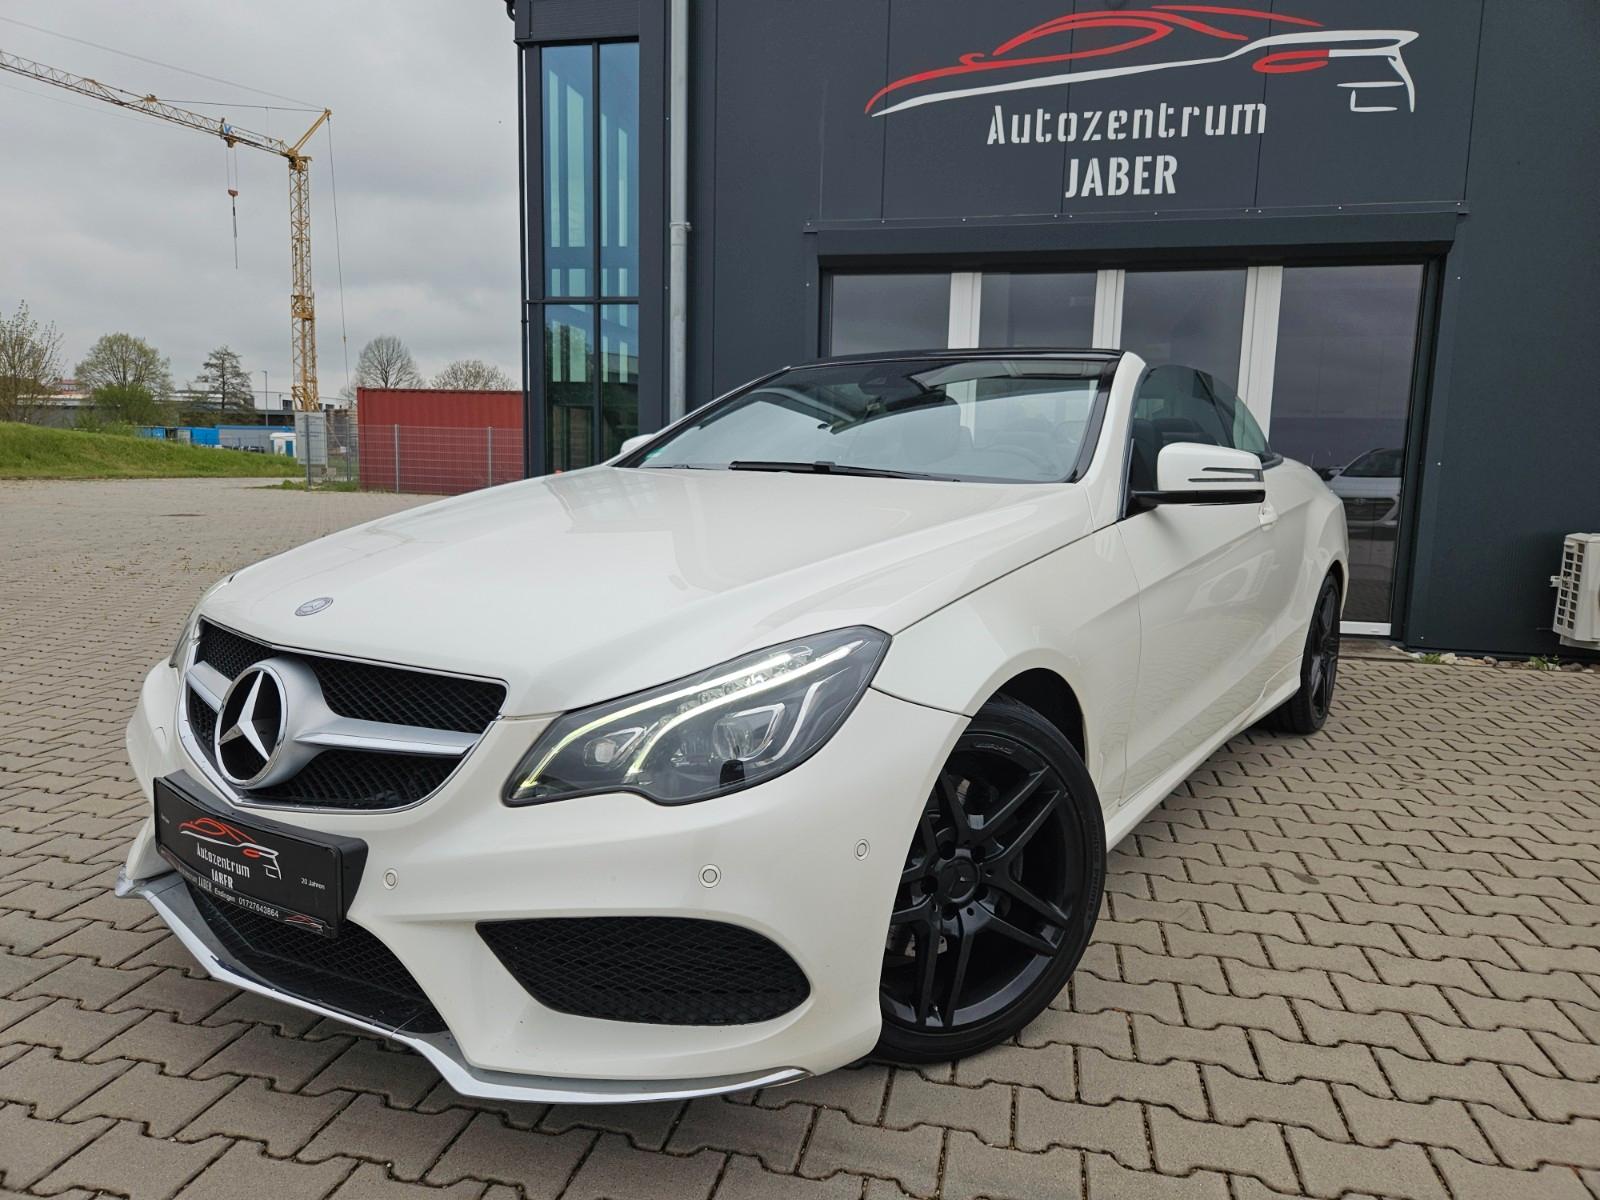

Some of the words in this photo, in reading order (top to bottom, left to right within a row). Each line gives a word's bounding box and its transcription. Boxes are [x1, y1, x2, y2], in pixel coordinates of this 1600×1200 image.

[986, 102, 1267, 145] Autozentrum
[1064, 155, 1178, 198] JABER
[196, 843, 250, 879] Autozentrum
